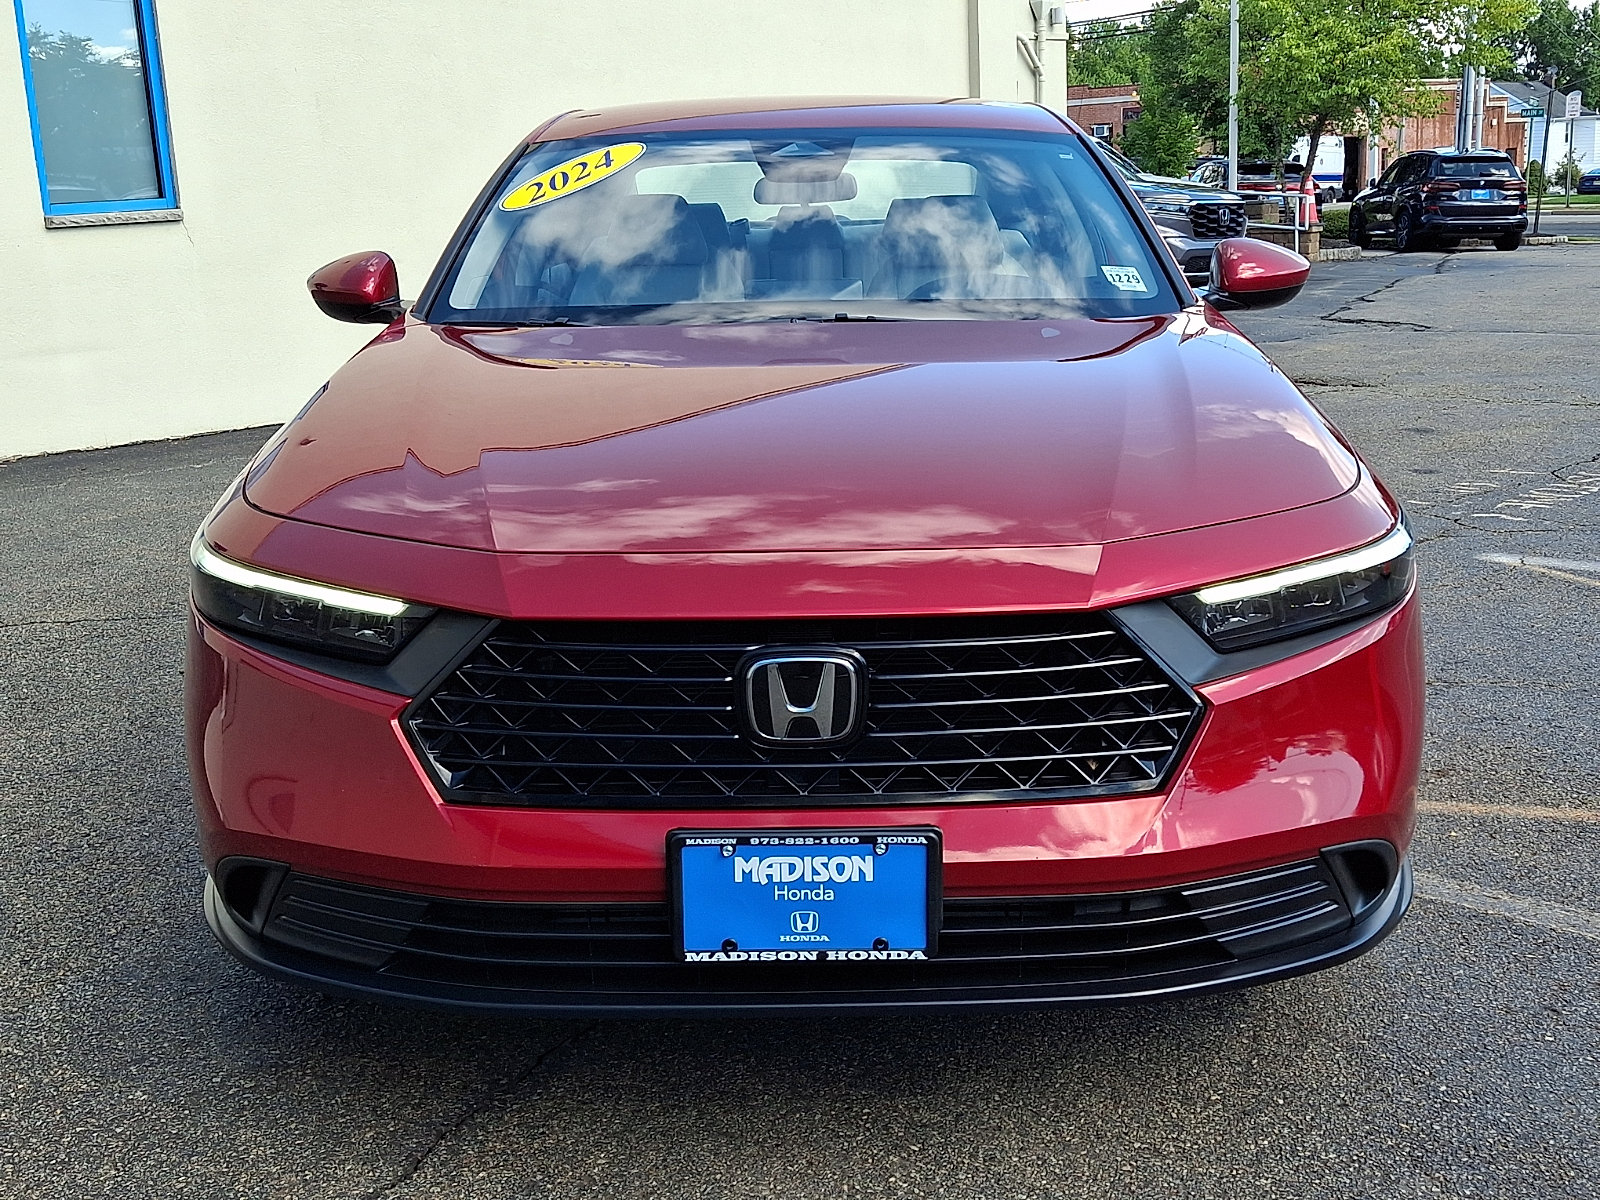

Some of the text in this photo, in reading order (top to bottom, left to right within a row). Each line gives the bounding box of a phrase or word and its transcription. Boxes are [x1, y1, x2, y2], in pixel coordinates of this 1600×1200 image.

[1522, 109, 1537, 117] MAIN
[525, 149, 615, 204] 2024
[749, 836, 860, 845] 973-822-1600
[876, 836, 928, 844] HONDA
[733, 855, 874, 886] MADISON
[774, 884, 835, 901] Honda
[684, 950, 928, 962] MADISON HONDA
